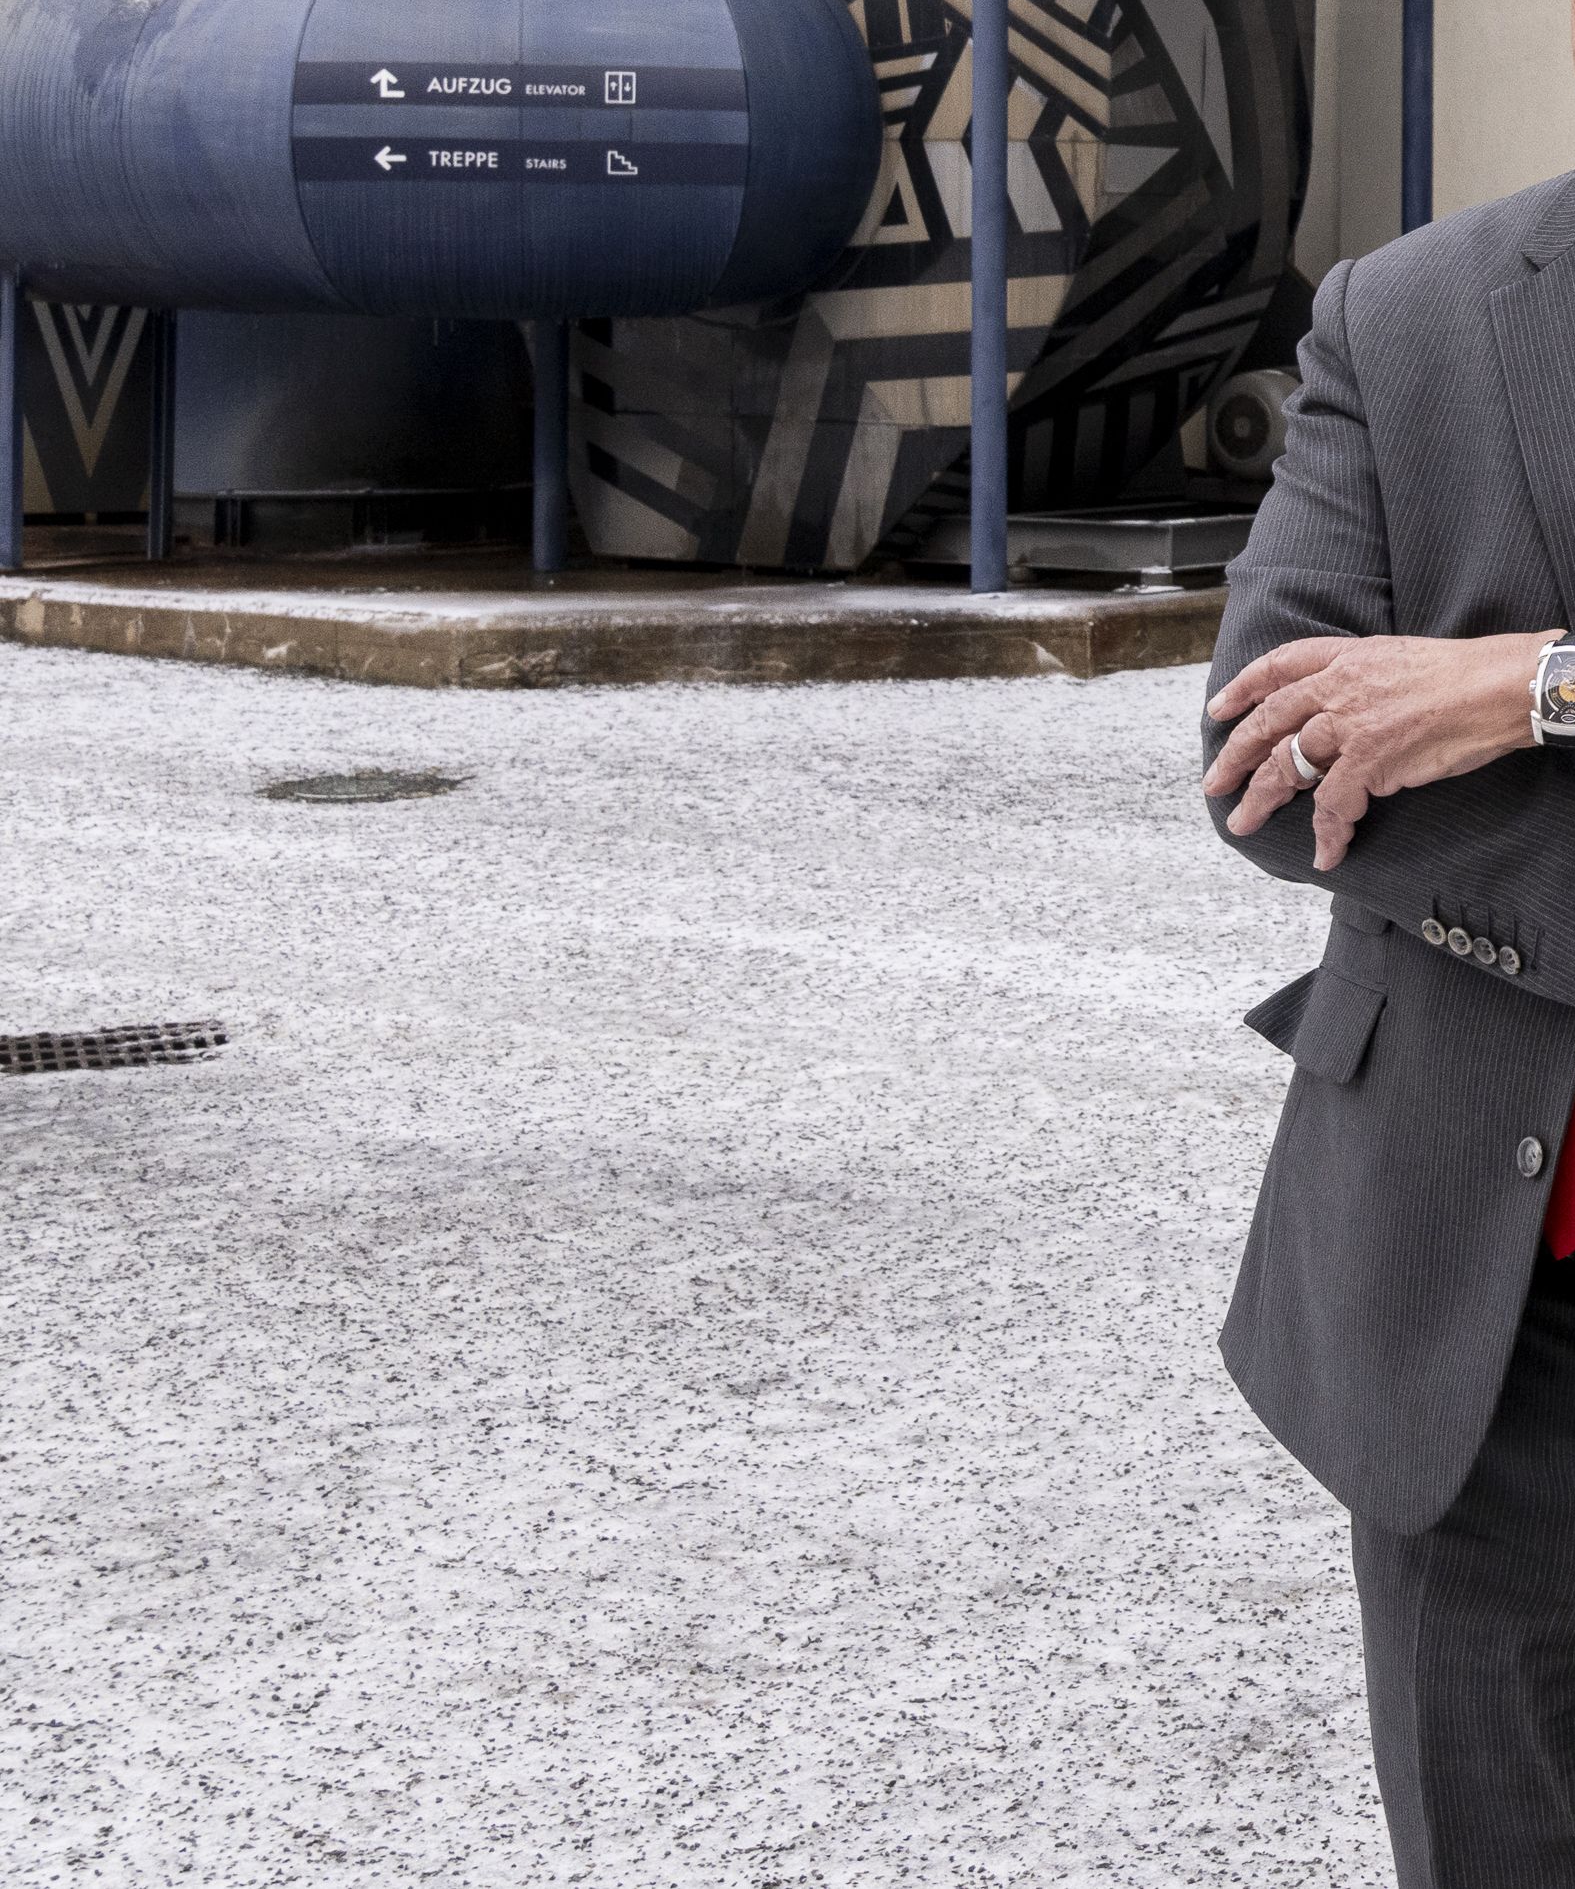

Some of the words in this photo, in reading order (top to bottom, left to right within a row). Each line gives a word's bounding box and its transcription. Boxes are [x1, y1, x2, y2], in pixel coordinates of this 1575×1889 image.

[427, 76, 512, 95] AUFZUG
[525, 84, 586, 95] ELEVATOR
[428, 151, 499, 168] TREPPE
[525, 158, 567, 170] STAIRS
